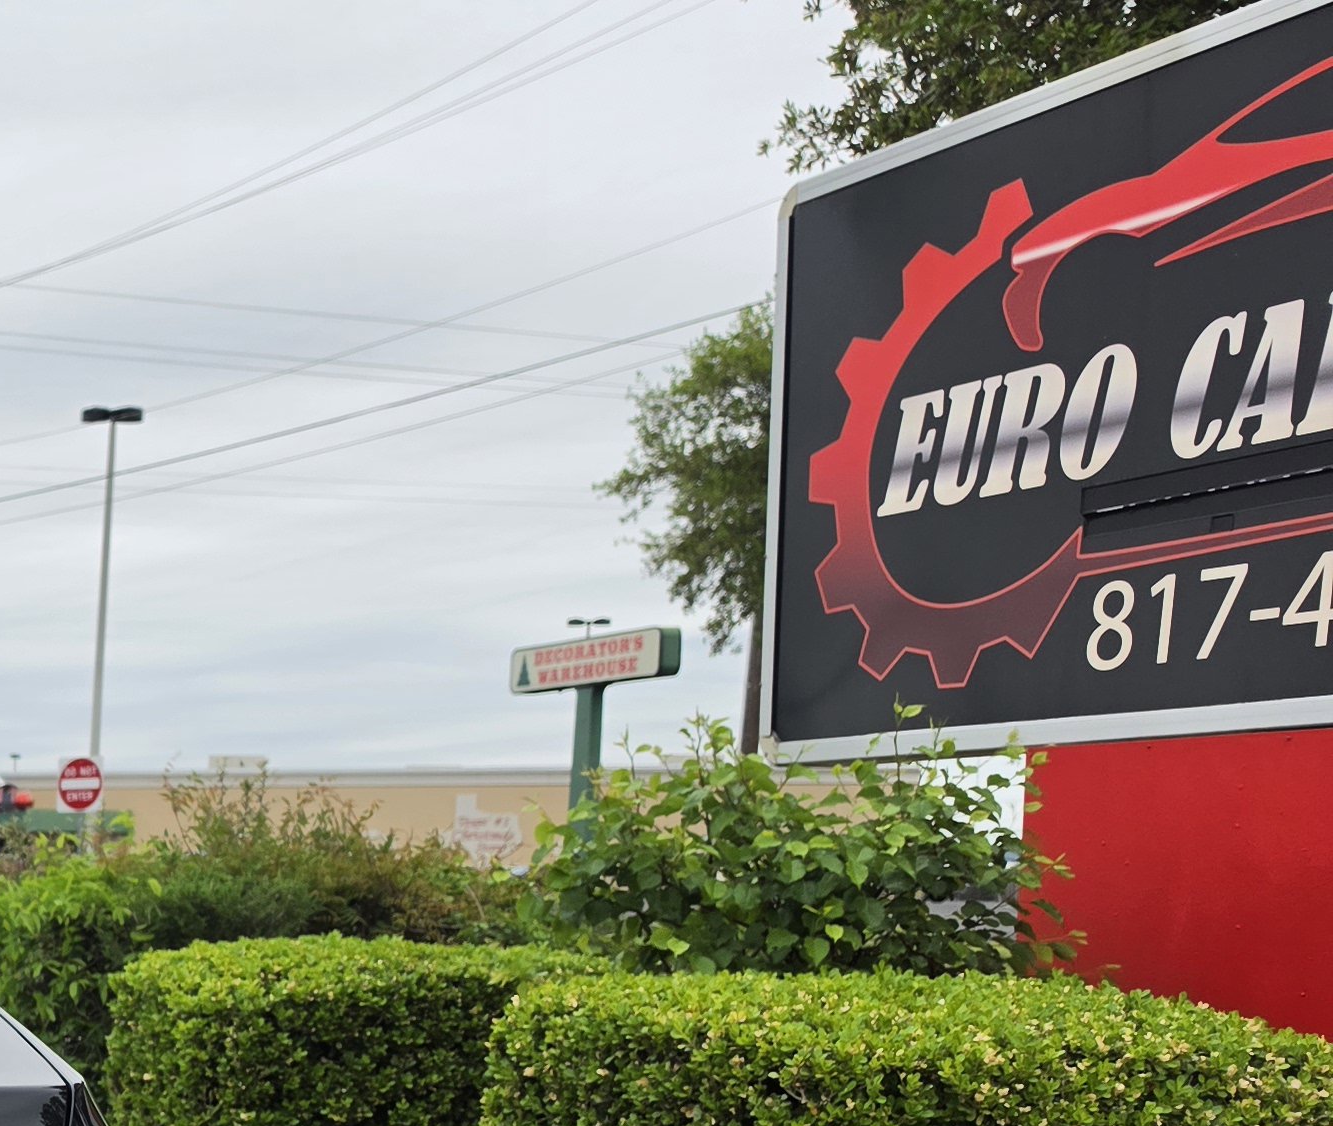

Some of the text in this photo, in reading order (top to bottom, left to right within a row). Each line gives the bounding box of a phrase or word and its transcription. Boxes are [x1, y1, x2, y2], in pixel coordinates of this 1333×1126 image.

[877, 343, 1138, 517] EURO
[534, 634, 644, 667] DECORATOR'S
[537, 657, 638, 685] WAREHOUSE
[64, 765, 97, 778] DO NOT
[66, 791, 93, 802] ENTER
